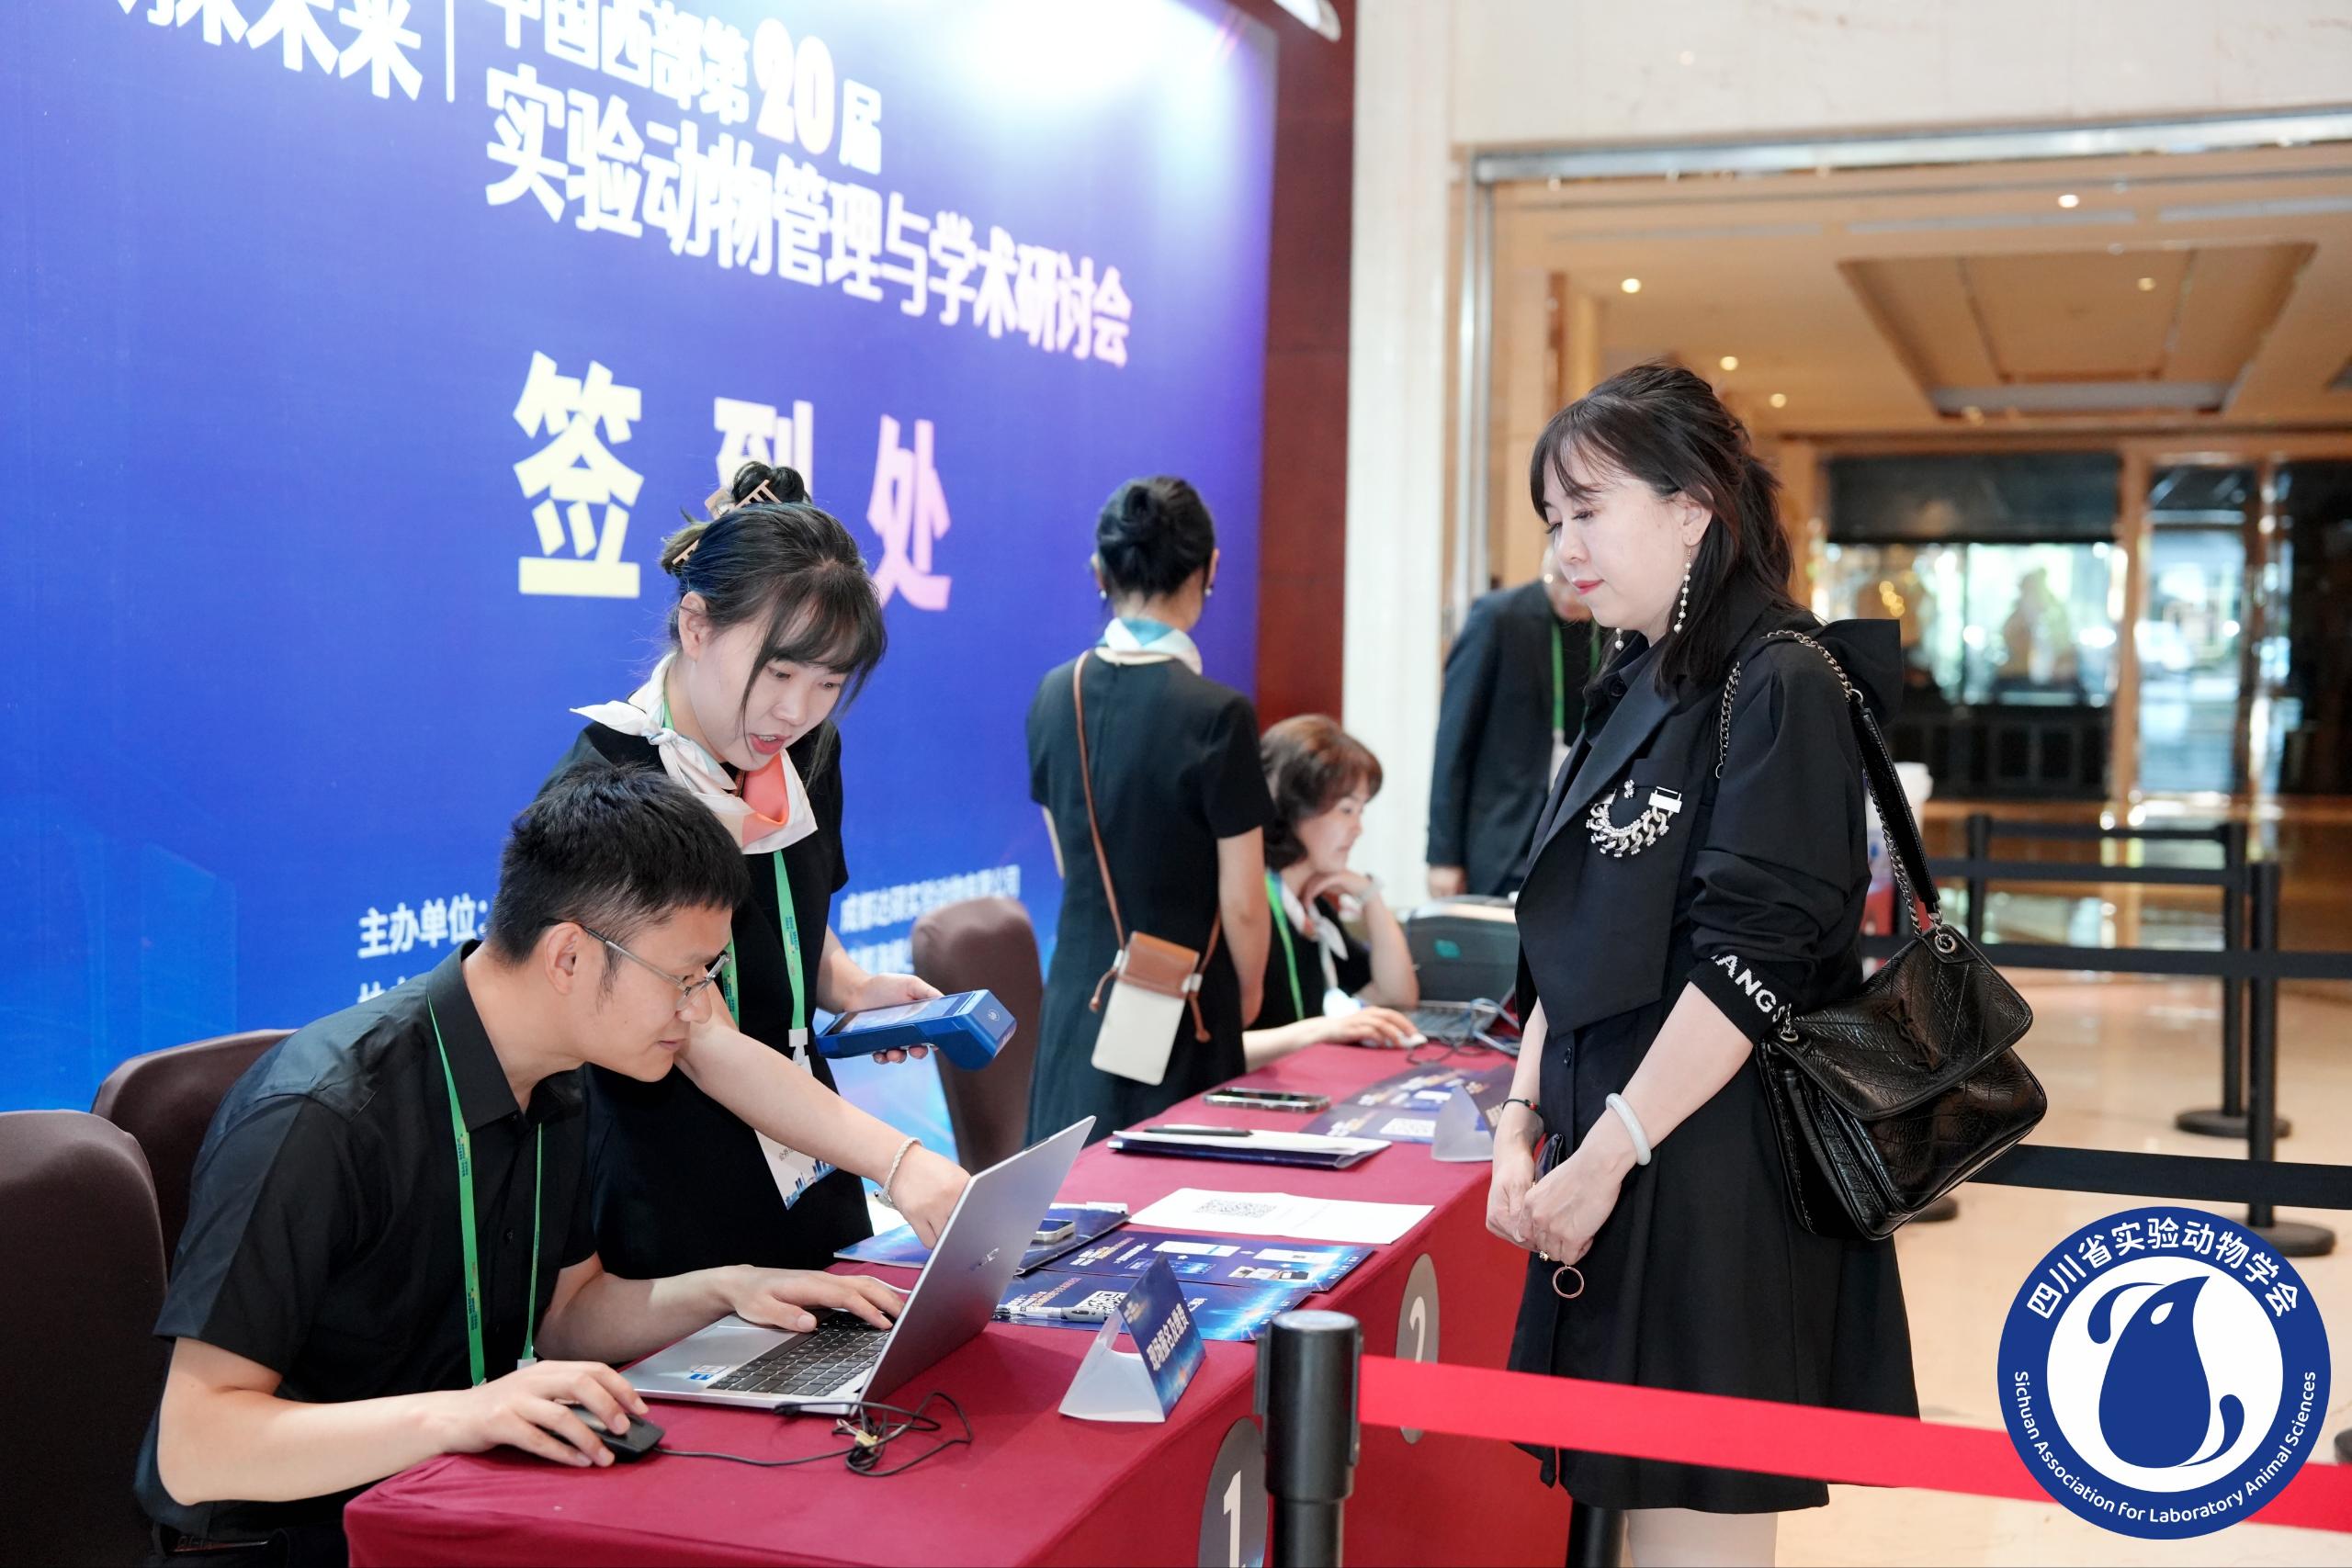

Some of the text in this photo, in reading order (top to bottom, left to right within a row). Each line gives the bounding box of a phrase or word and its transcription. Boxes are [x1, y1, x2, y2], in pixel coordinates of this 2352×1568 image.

[485, 63, 1132, 368] 实验动物管理与学术研讨会
[1223, 1470, 1241, 1568] 1
